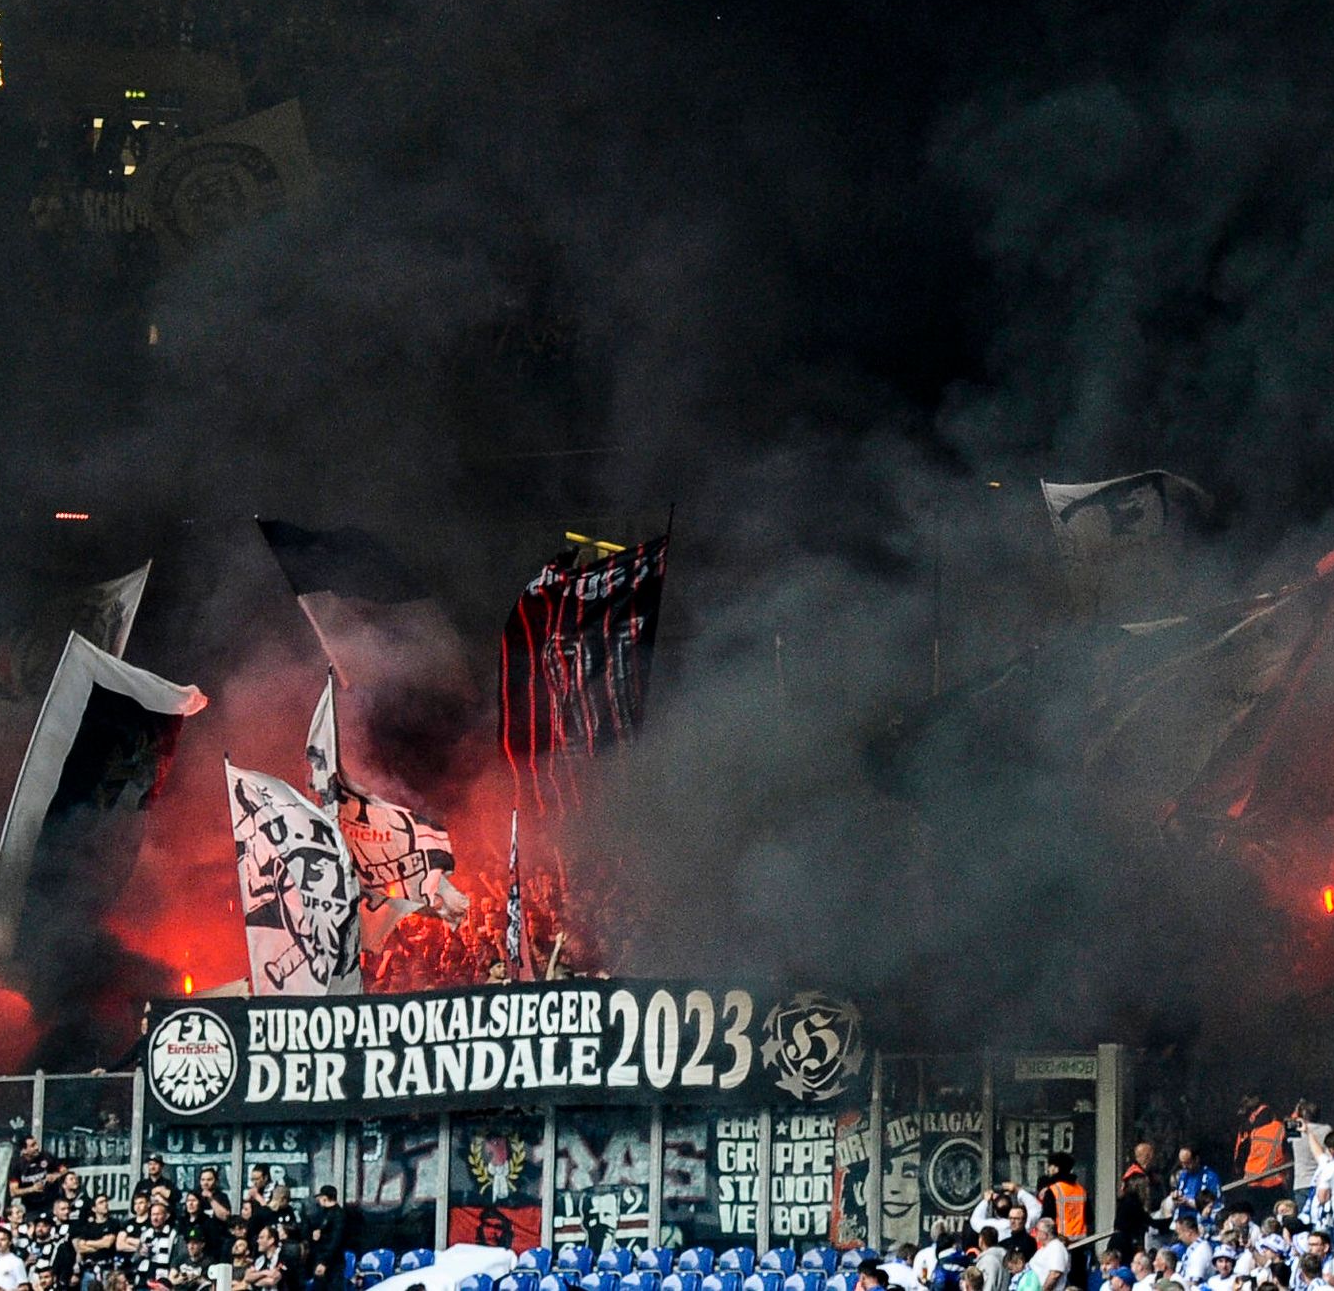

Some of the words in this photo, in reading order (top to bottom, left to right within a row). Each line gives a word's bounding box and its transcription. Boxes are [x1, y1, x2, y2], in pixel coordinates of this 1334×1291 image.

[167, 1043, 219, 1056] Eintracht
[247, 991, 603, 1052] EUROPAPOKALSIEGER
[607, 989, 754, 1090] 2023
[244, 1051, 347, 1103] DER
[362, 1037, 602, 1100] RANDALE
[719, 1204, 832, 1236] VEBOT
